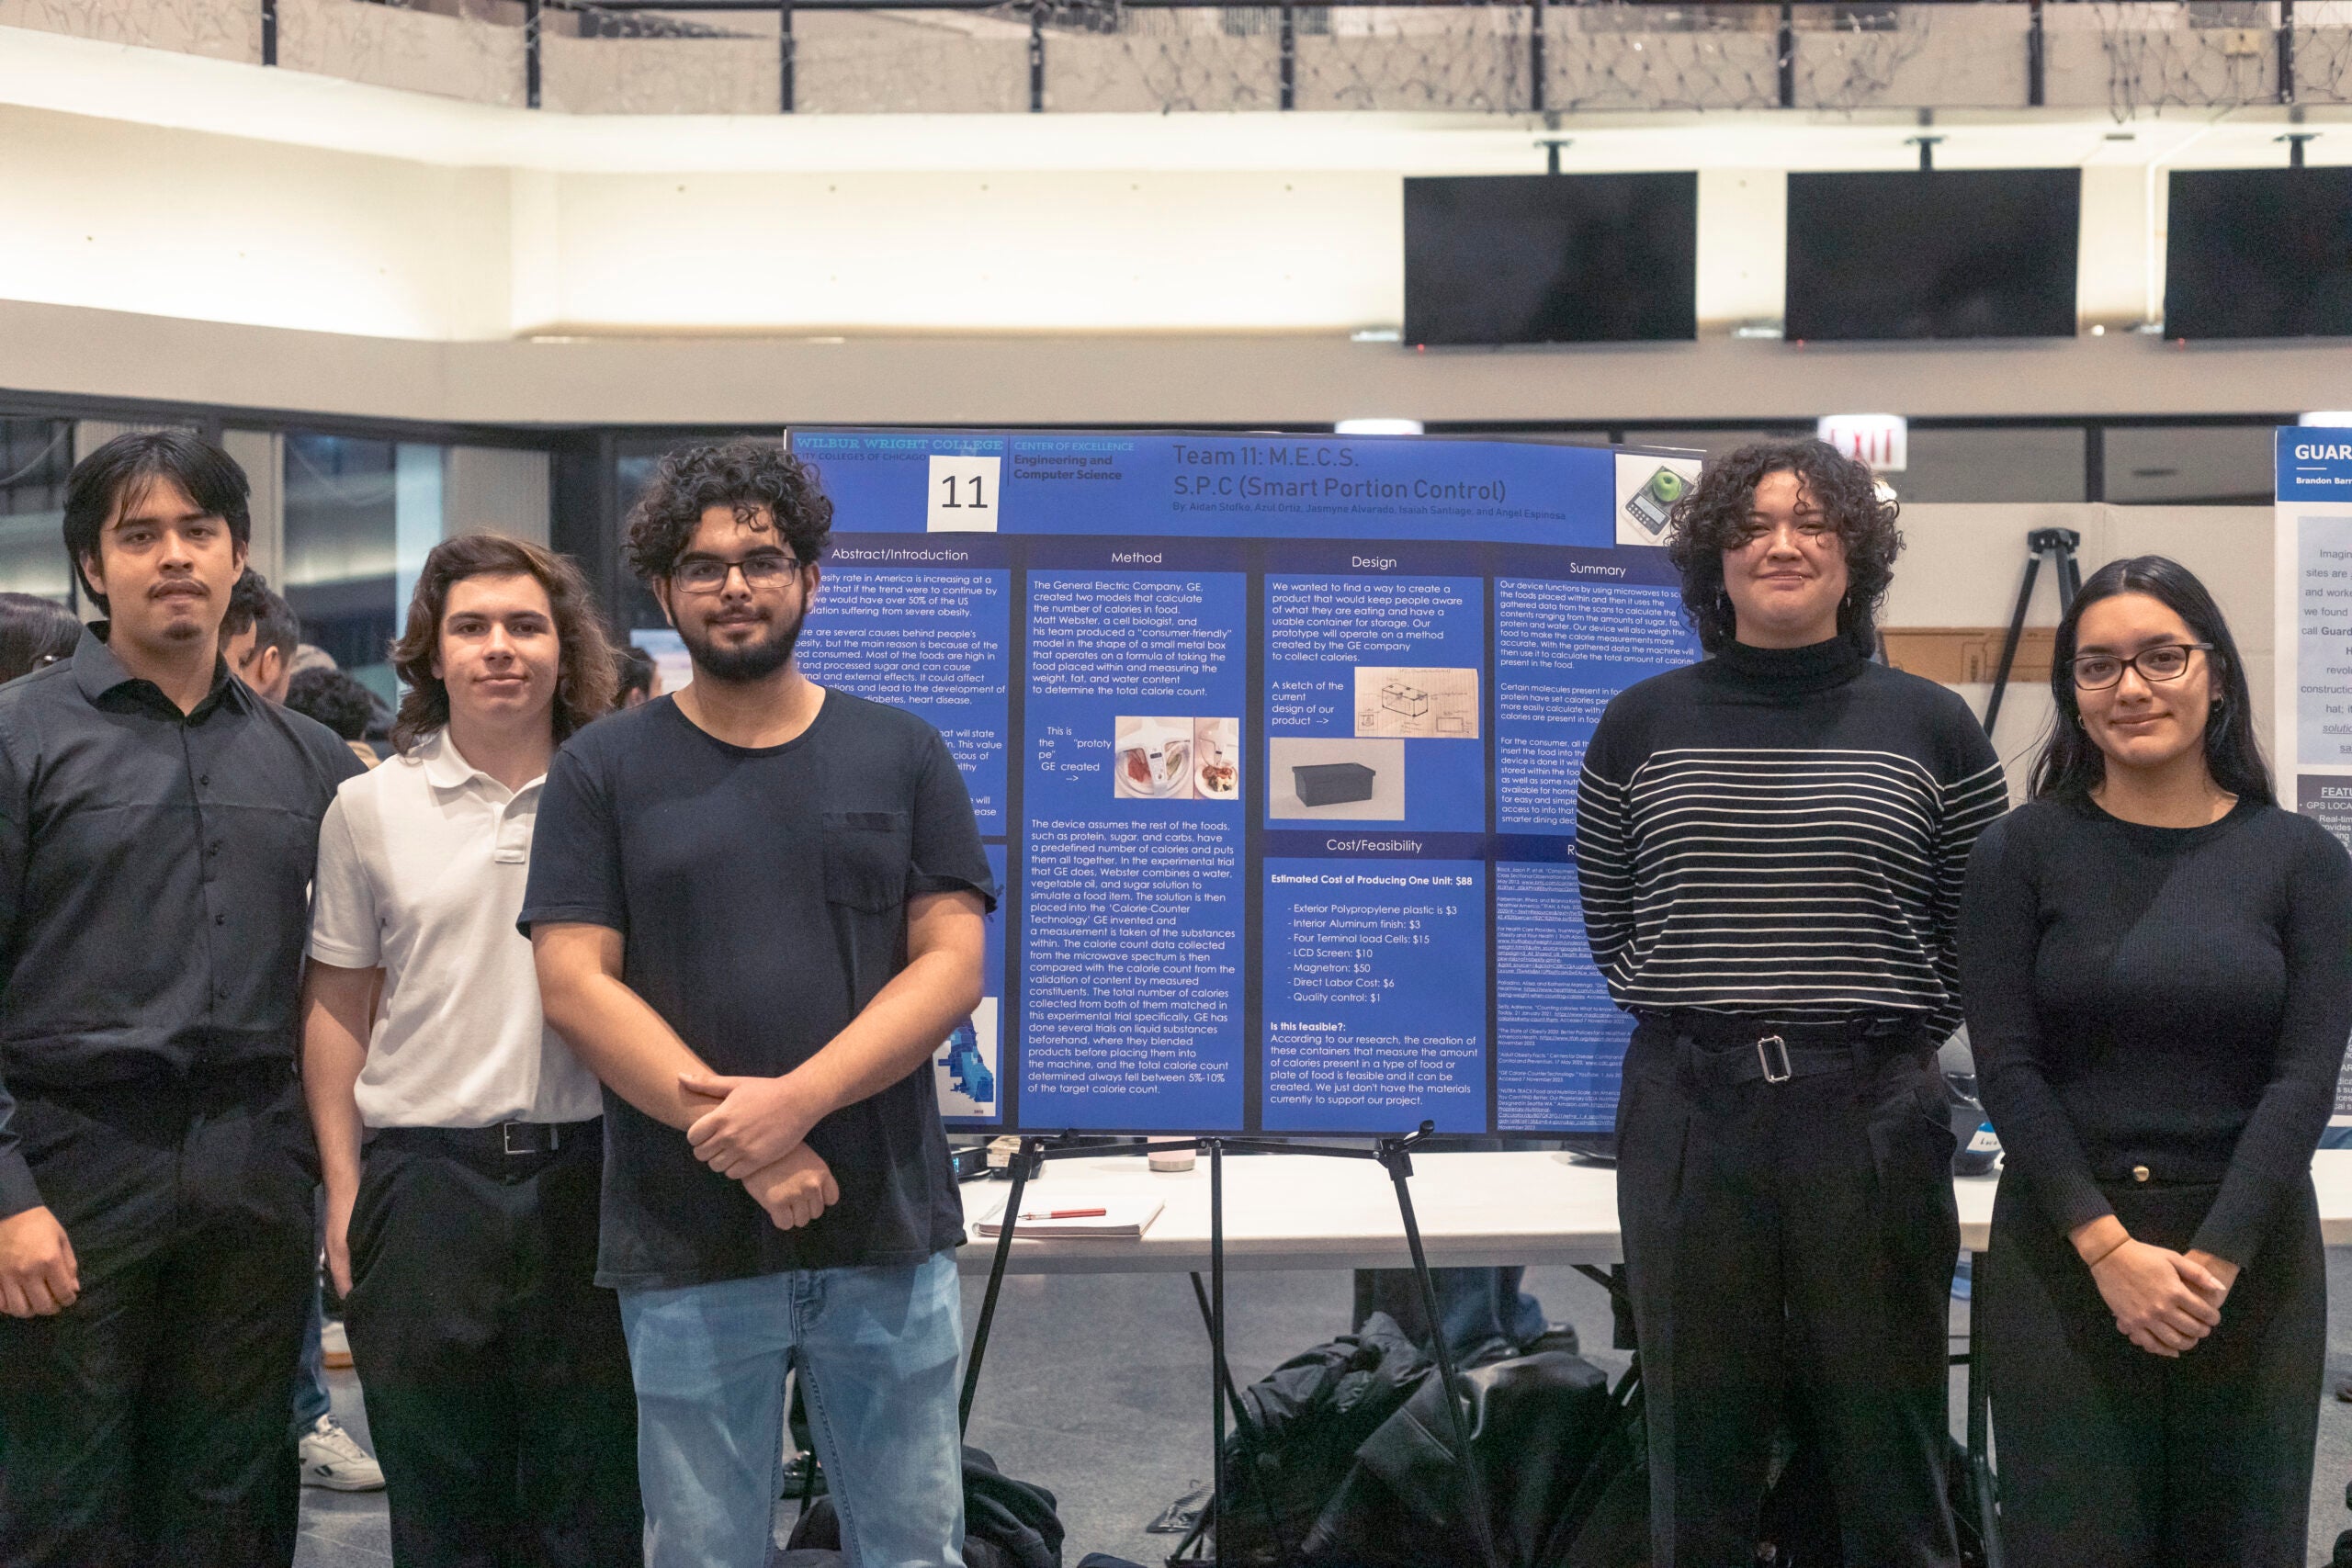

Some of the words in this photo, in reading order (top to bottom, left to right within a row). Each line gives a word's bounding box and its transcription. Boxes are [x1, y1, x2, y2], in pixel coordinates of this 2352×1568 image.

[797, 438, 860, 448] WILBUR
[864, 439, 928, 449] WRIGHT
[933, 440, 1003, 450] COLLEGE
[1014, 442, 1053, 450] CENTER
[1056, 442, 1070, 451] OF
[1072, 442, 1135, 451] EXCELLENCE
[818, 452, 865, 461] COLLEGES
[1014, 455, 1087, 467] Engineering
[1090, 456, 1113, 465] and
[1173, 445, 1235, 465] Team
[1241, 447, 1263, 465] 11:
[1269, 447, 1359, 467] M.E.C.S.
[1014, 469, 1074, 481] Computer
[1076, 470, 1122, 480] Science
[942, 475, 988, 508] 11
[1174, 475, 1233, 496] S.P.C
[1240, 475, 1318, 498] (Smart
[1324, 478, 1408, 498] Portion
[1414, 479, 1506, 503] Control)
[1306, 504, 1349, 514] Jasmyne
[1399, 505, 1427, 514] Isaiah
[1476, 508, 1493, 516] and
[1496, 508, 1522, 519] Angel
[1524, 509, 1566, 520] Espinosa
[831, 548, 968, 561] Abstract/Introduction
[1112, 551, 1162, 564] Method
[1352, 556, 1397, 570] Design
[1570, 562, 1626, 578] Summary
[2306, 569, 2329, 577] sites
[842, 573, 862, 582] rate
[864, 574, 872, 583] in
[874, 574, 913, 583] America
[915, 574, 921, 583] is
[923, 574, 970, 586] increasing
[972, 575, 982, 584] at
[1034, 580, 1051, 589] The
[1053, 580, 1092, 590] General
[1095, 581, 1130, 590] Electric
[1272, 582, 1288, 591] We
[1290, 582, 1327, 592] wanted
[1331, 583, 1341, 592] to
[1343, 583, 1361, 592] find
[1373, 586, 1393, 594] way
[1396, 583, 1406, 593] to
[1408, 584, 1440, 593] create
[1499, 580, 1515, 589] Our
[1516, 581, 1544, 590] device
[1545, 583, 1580, 592] functions
[1580, 584, 1591, 595] by
[1592, 585, 1612, 596] using
[1613, 586, 1660, 596] microwaves
[1661, 588, 1669, 597] to
[2305, 588, 2323, 597] and
[841, 606, 879, 617] suffering
[882, 606, 903, 616] from
[937, 607, 972, 618] obesity.
[2304, 608, 2318, 616] we
[2321, 607, 2348, 616] found
[2301, 626, 2318, 635] call
[1272, 681, 1279, 690] A
[1282, 681, 1313, 690] sketch
[1315, 681, 1325, 690] of
[1328, 681, 1344, 690] the
[1272, 692, 1306, 701] current
[1272, 704, 1303, 715] design
[1306, 704, 1316, 713] of
[1272, 715, 1310, 727] product
[956, 729, 970, 738] will
[1047, 726, 1063, 735] This
[1066, 726, 1072, 735] is
[958, 740, 973, 749] This
[976, 741, 1002, 749] value
[1039, 739, 1054, 747] the
[1041, 761, 1055, 770] GE
[1060, 761, 1100, 771] created
[1327, 839, 1422, 853] Cost/Feasibility
[1271, 874, 1318, 884] Estimated
[1320, 875, 1343, 884] Cost
[1344, 875, 1355, 884] of
[1357, 875, 1406, 887] Producing
[1408, 876, 1429, 885] One
[1432, 876, 1452, 885] Unit:
[1455, 876, 1472, 886] $88
[1294, 904, 1328, 913] Exterior
[1331, 904, 1400, 916] Polypropylene
[1403, 905, 1434, 916] plastic
[1437, 905, 1443, 914] is
[1445, 905, 1457, 915] $3
[1293, 919, 1326, 928] Interior
[1329, 919, 1378, 928] Aluminum
[1380, 919, 1406, 929] finish:
[1409, 920, 1420, 930] $3
[1293, 933, 1314, 942] Four
[1317, 934, 1357, 943] Terminal
[1359, 934, 1382, 943] load
[1384, 934, 1410, 944] Cells:
[1412, 935, 1429, 945] $15
[1293, 948, 1314, 957] LCD
[1316, 948, 1352, 957] Screen:
[1355, 949, 1373, 959] $10
[1293, 963, 1350, 975] Magnetron:
[1353, 964, 1370, 974] $50
[1293, 977, 1322, 987] Direct
[1325, 978, 1353, 987] Labor
[1355, 978, 1380, 987] Cost:
[1383, 978, 1394, 988] $6
[1293, 992, 1328, 1004] Quality
[1330, 993, 1367, 1002] control:
[1370, 993, 1380, 1003] $1
[1270, 1022, 1278, 1031] Is
[1280, 1022, 1297, 1031] this
[1027, 1084, 1038, 1093] of
[1040, 1084, 1056, 1093] the
[1059, 1084, 1089, 1095] target
[1092, 1084, 1126, 1093] calorie
[1128, 1085, 1160, 1094] count.
[1270, 1094, 1312, 1106] currently
[1315, 1095, 1325, 1104] to
[1327, 1095, 1365, 1106] support
[1385, 1095, 1422, 1107] project.
